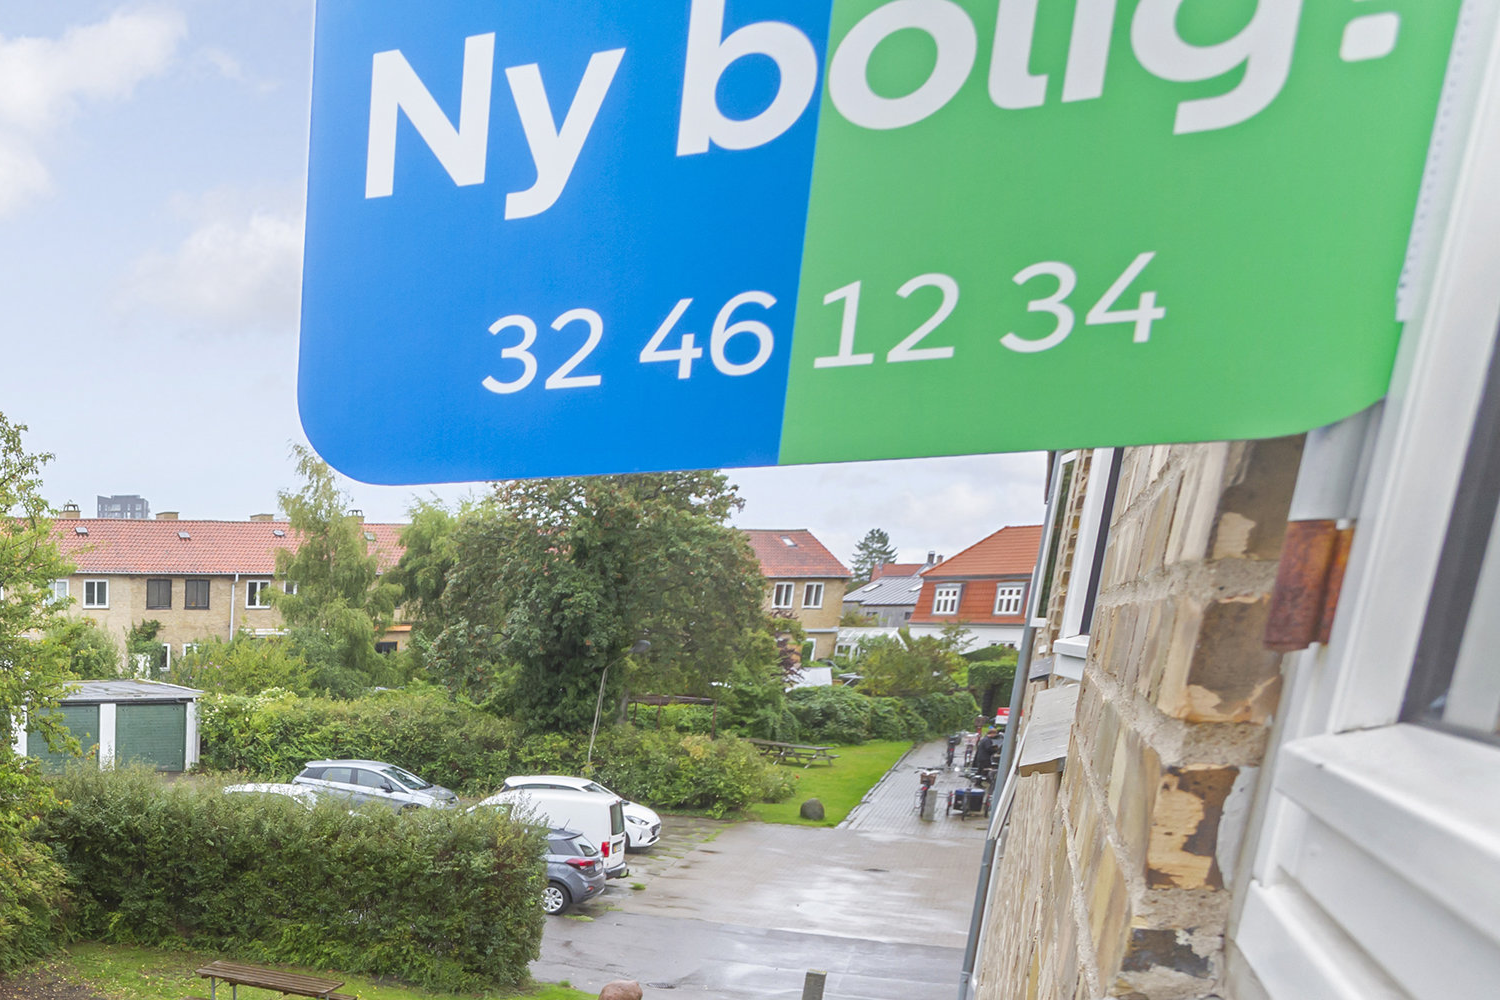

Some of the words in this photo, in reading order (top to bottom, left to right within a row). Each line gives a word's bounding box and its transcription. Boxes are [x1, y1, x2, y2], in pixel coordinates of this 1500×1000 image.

[365, 33, 626, 219] Ny
[677, 0, 1401, 155] bolig
[482, 308, 603, 394] 32
[639, 291, 777, 379] 46
[812, 272, 961, 370] 12
[1000, 250, 1168, 353] 34
